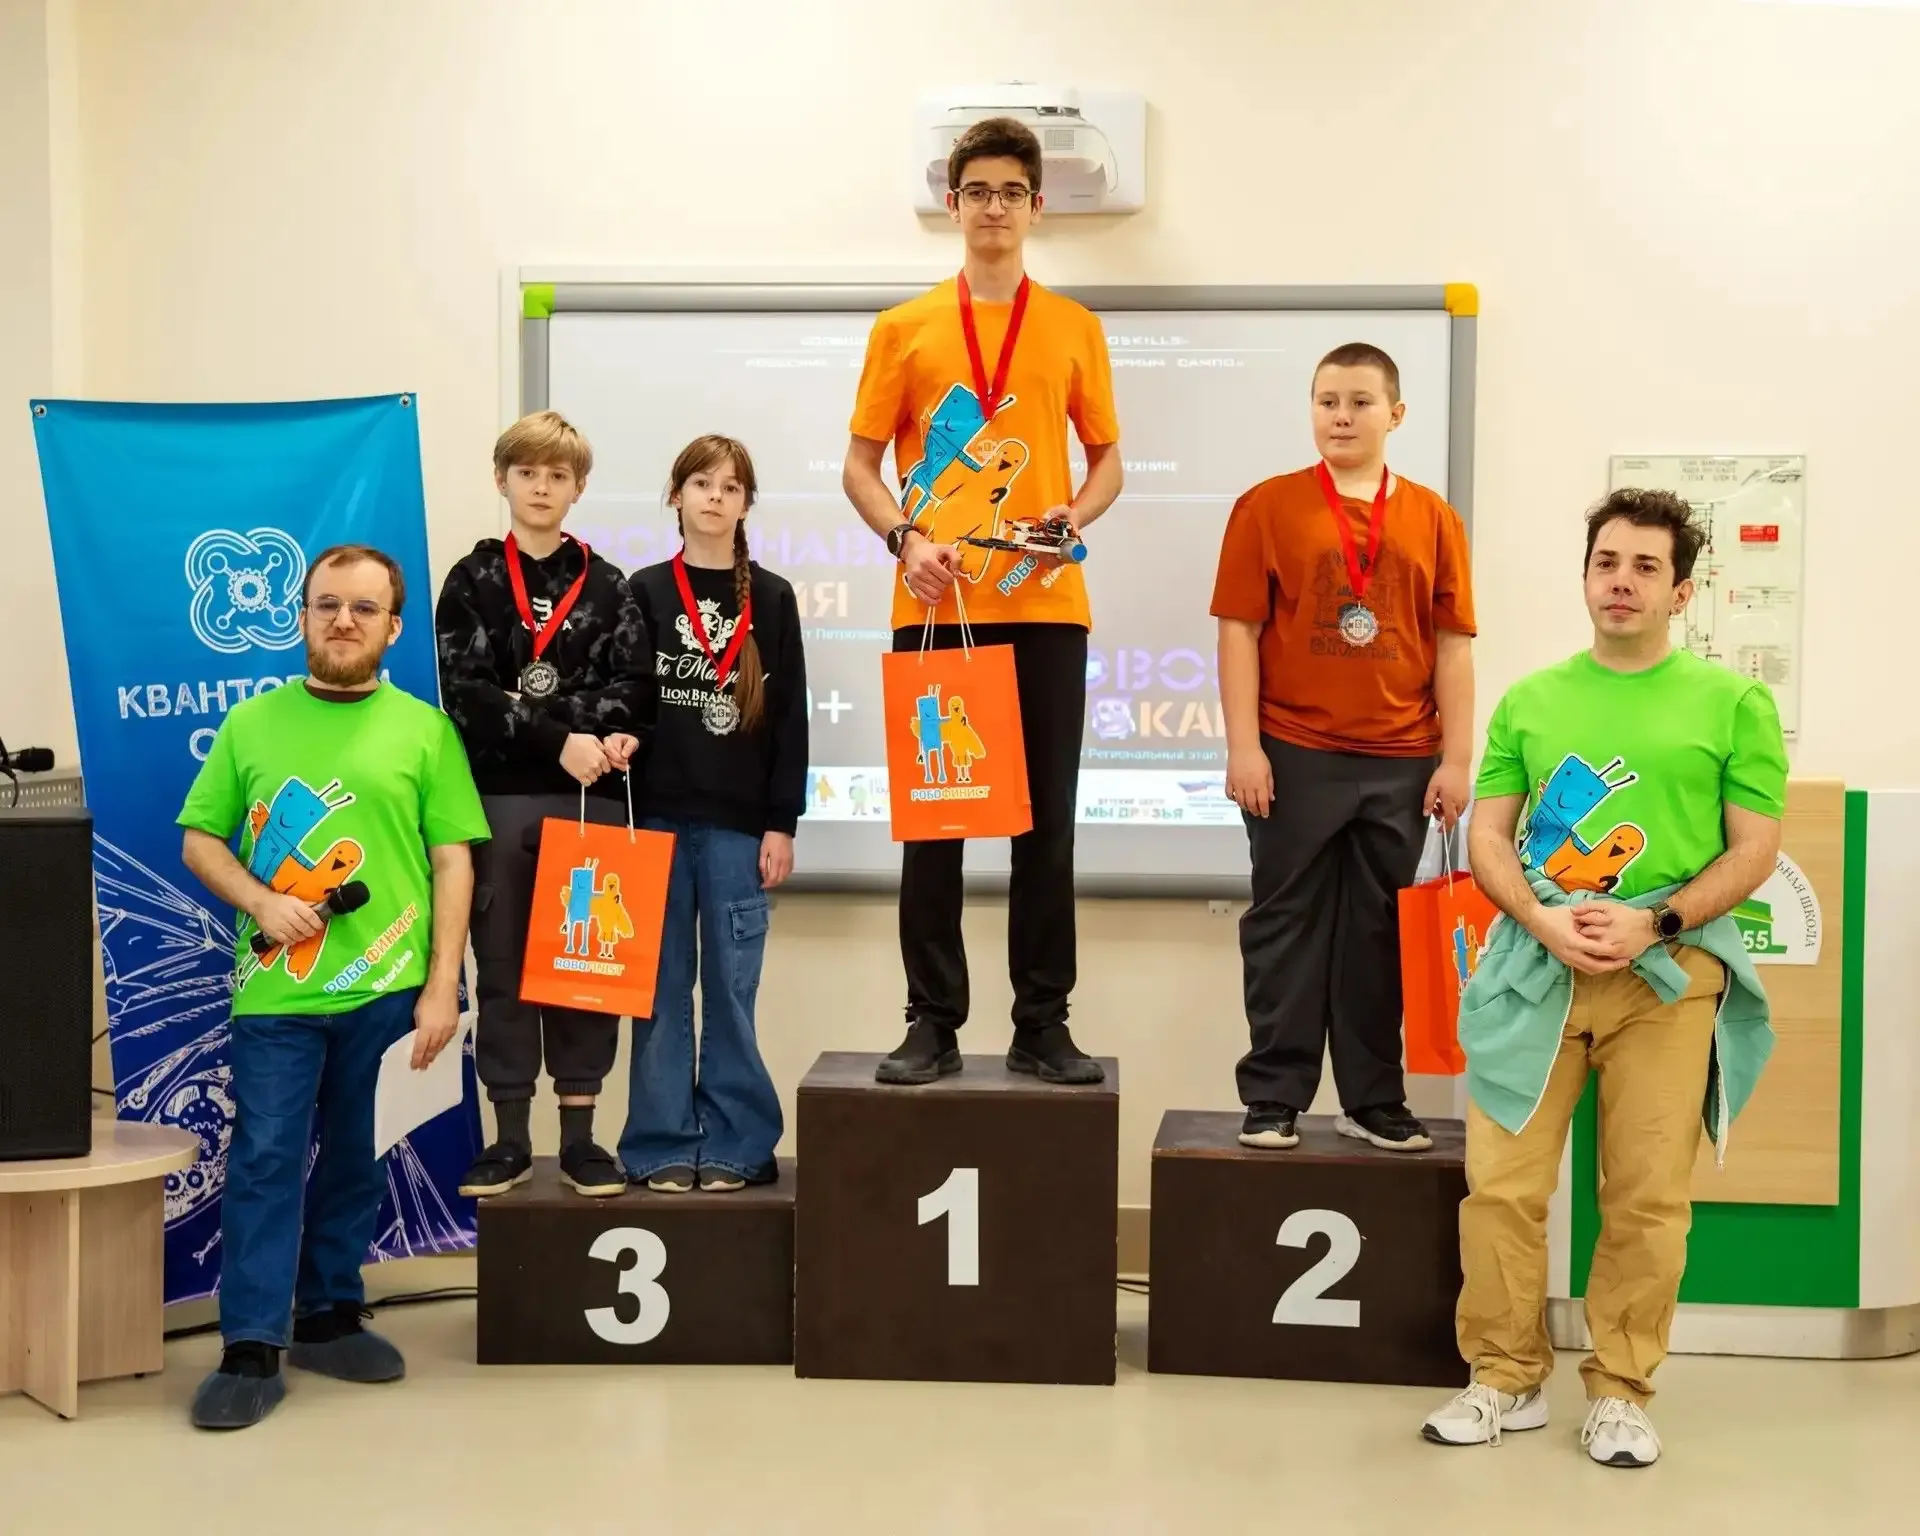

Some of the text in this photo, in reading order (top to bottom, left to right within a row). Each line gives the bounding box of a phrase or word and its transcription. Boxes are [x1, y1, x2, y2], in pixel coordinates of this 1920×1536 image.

[996, 553, 1039, 597] РОБО
[661, 686, 690, 701] LION
[911, 785, 991, 802] РОБОФИНИСТ
[323, 902, 419, 996] РОБОФИНИСТ
[1800, 895, 1817, 948] ШКОЛА
[917, 1167, 980, 1287] 1
[583, 1226, 672, 1346] 3
[1271, 1208, 1362, 1328] 2
